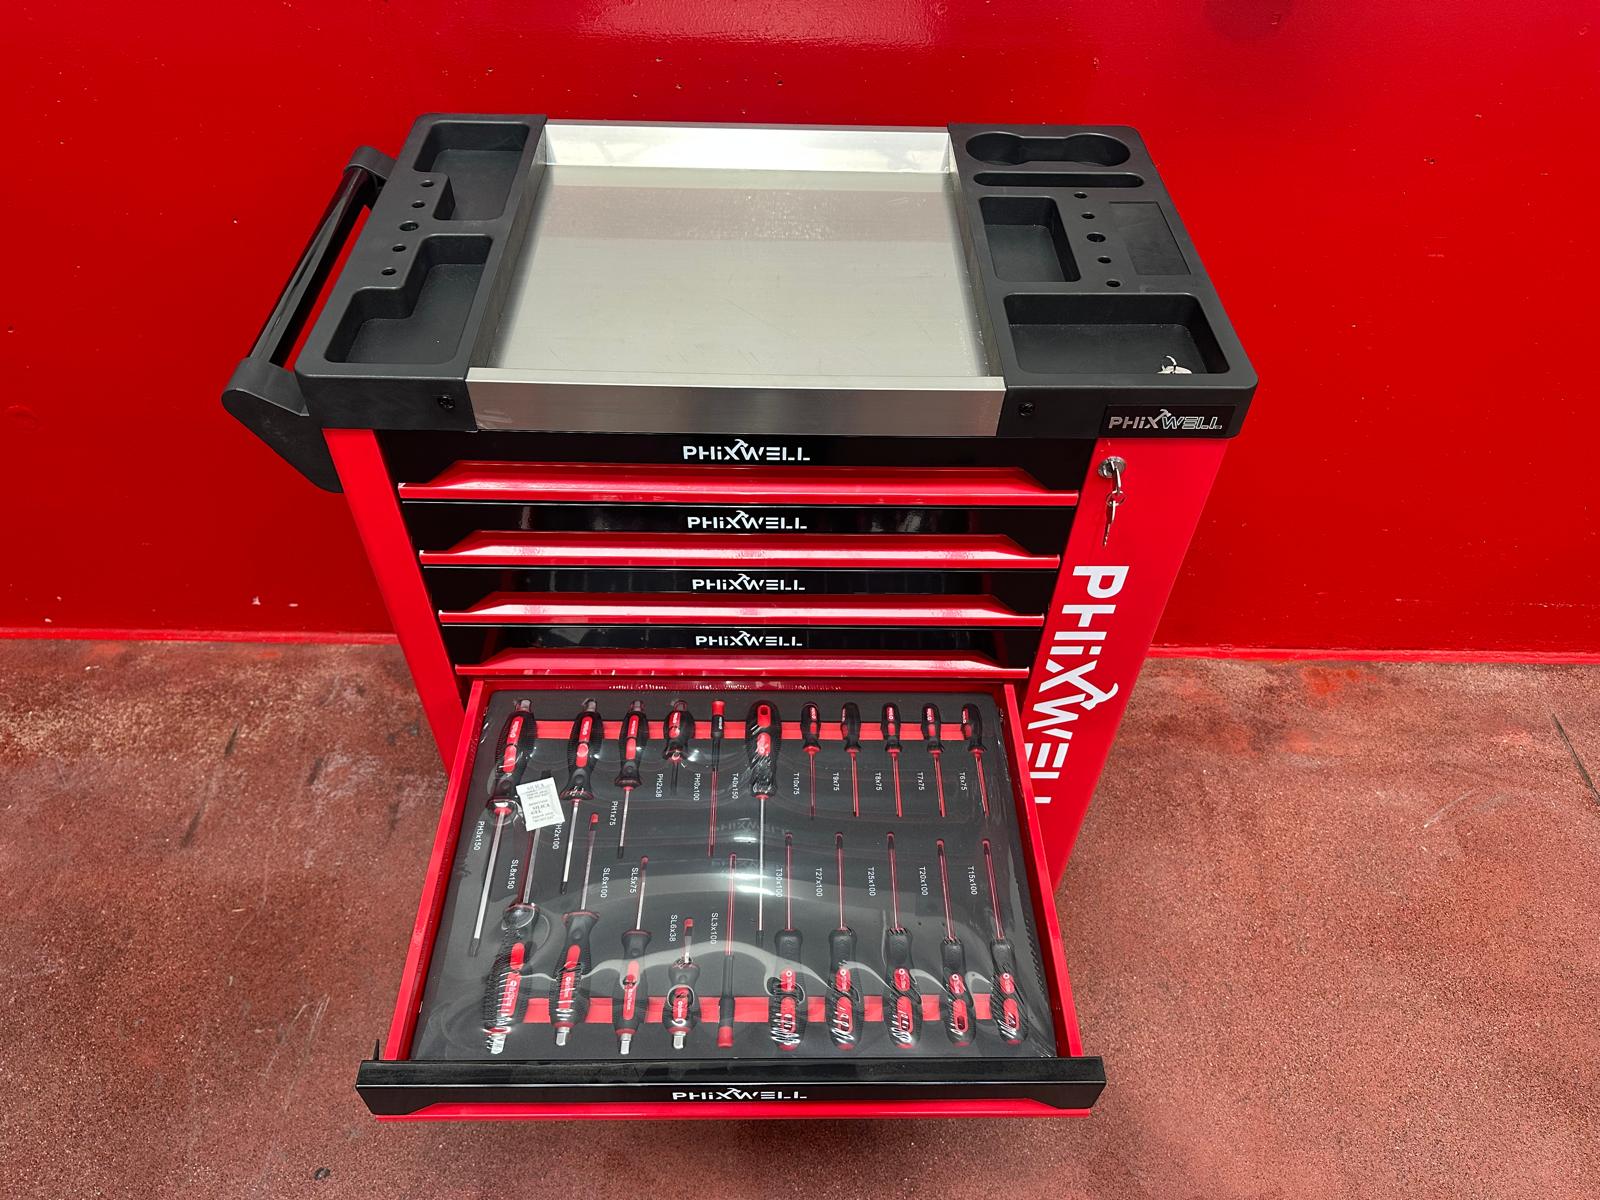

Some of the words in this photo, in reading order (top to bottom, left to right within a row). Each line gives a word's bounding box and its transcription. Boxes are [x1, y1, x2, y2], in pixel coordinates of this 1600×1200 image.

[655, 773, 664, 798] PH2x38
[693, 773, 701, 801] PH0x100
[731, 772, 739, 800] T40x150
[917, 772, 925, 791] T7x75
[959, 772, 968, 791] T6x75
[609, 800, 619, 826] PH1x75
[473, 820, 485, 851] PH3x150
[552, 823, 562, 850] H2x100
[507, 859, 519, 890] SL8x150
[600, 867, 611, 899] SL6x100
[629, 867, 639, 894] SL5x75
[775, 868, 783, 898] T30x100
[815, 867, 823, 897] T27x100
[867, 866, 877, 897] T25x100
[919, 866, 929, 896] T20x100
[967, 865, 977, 895] T15x100
[668, 914, 678, 942] SL6x38
[710, 912, 720, 945] SL3x100
